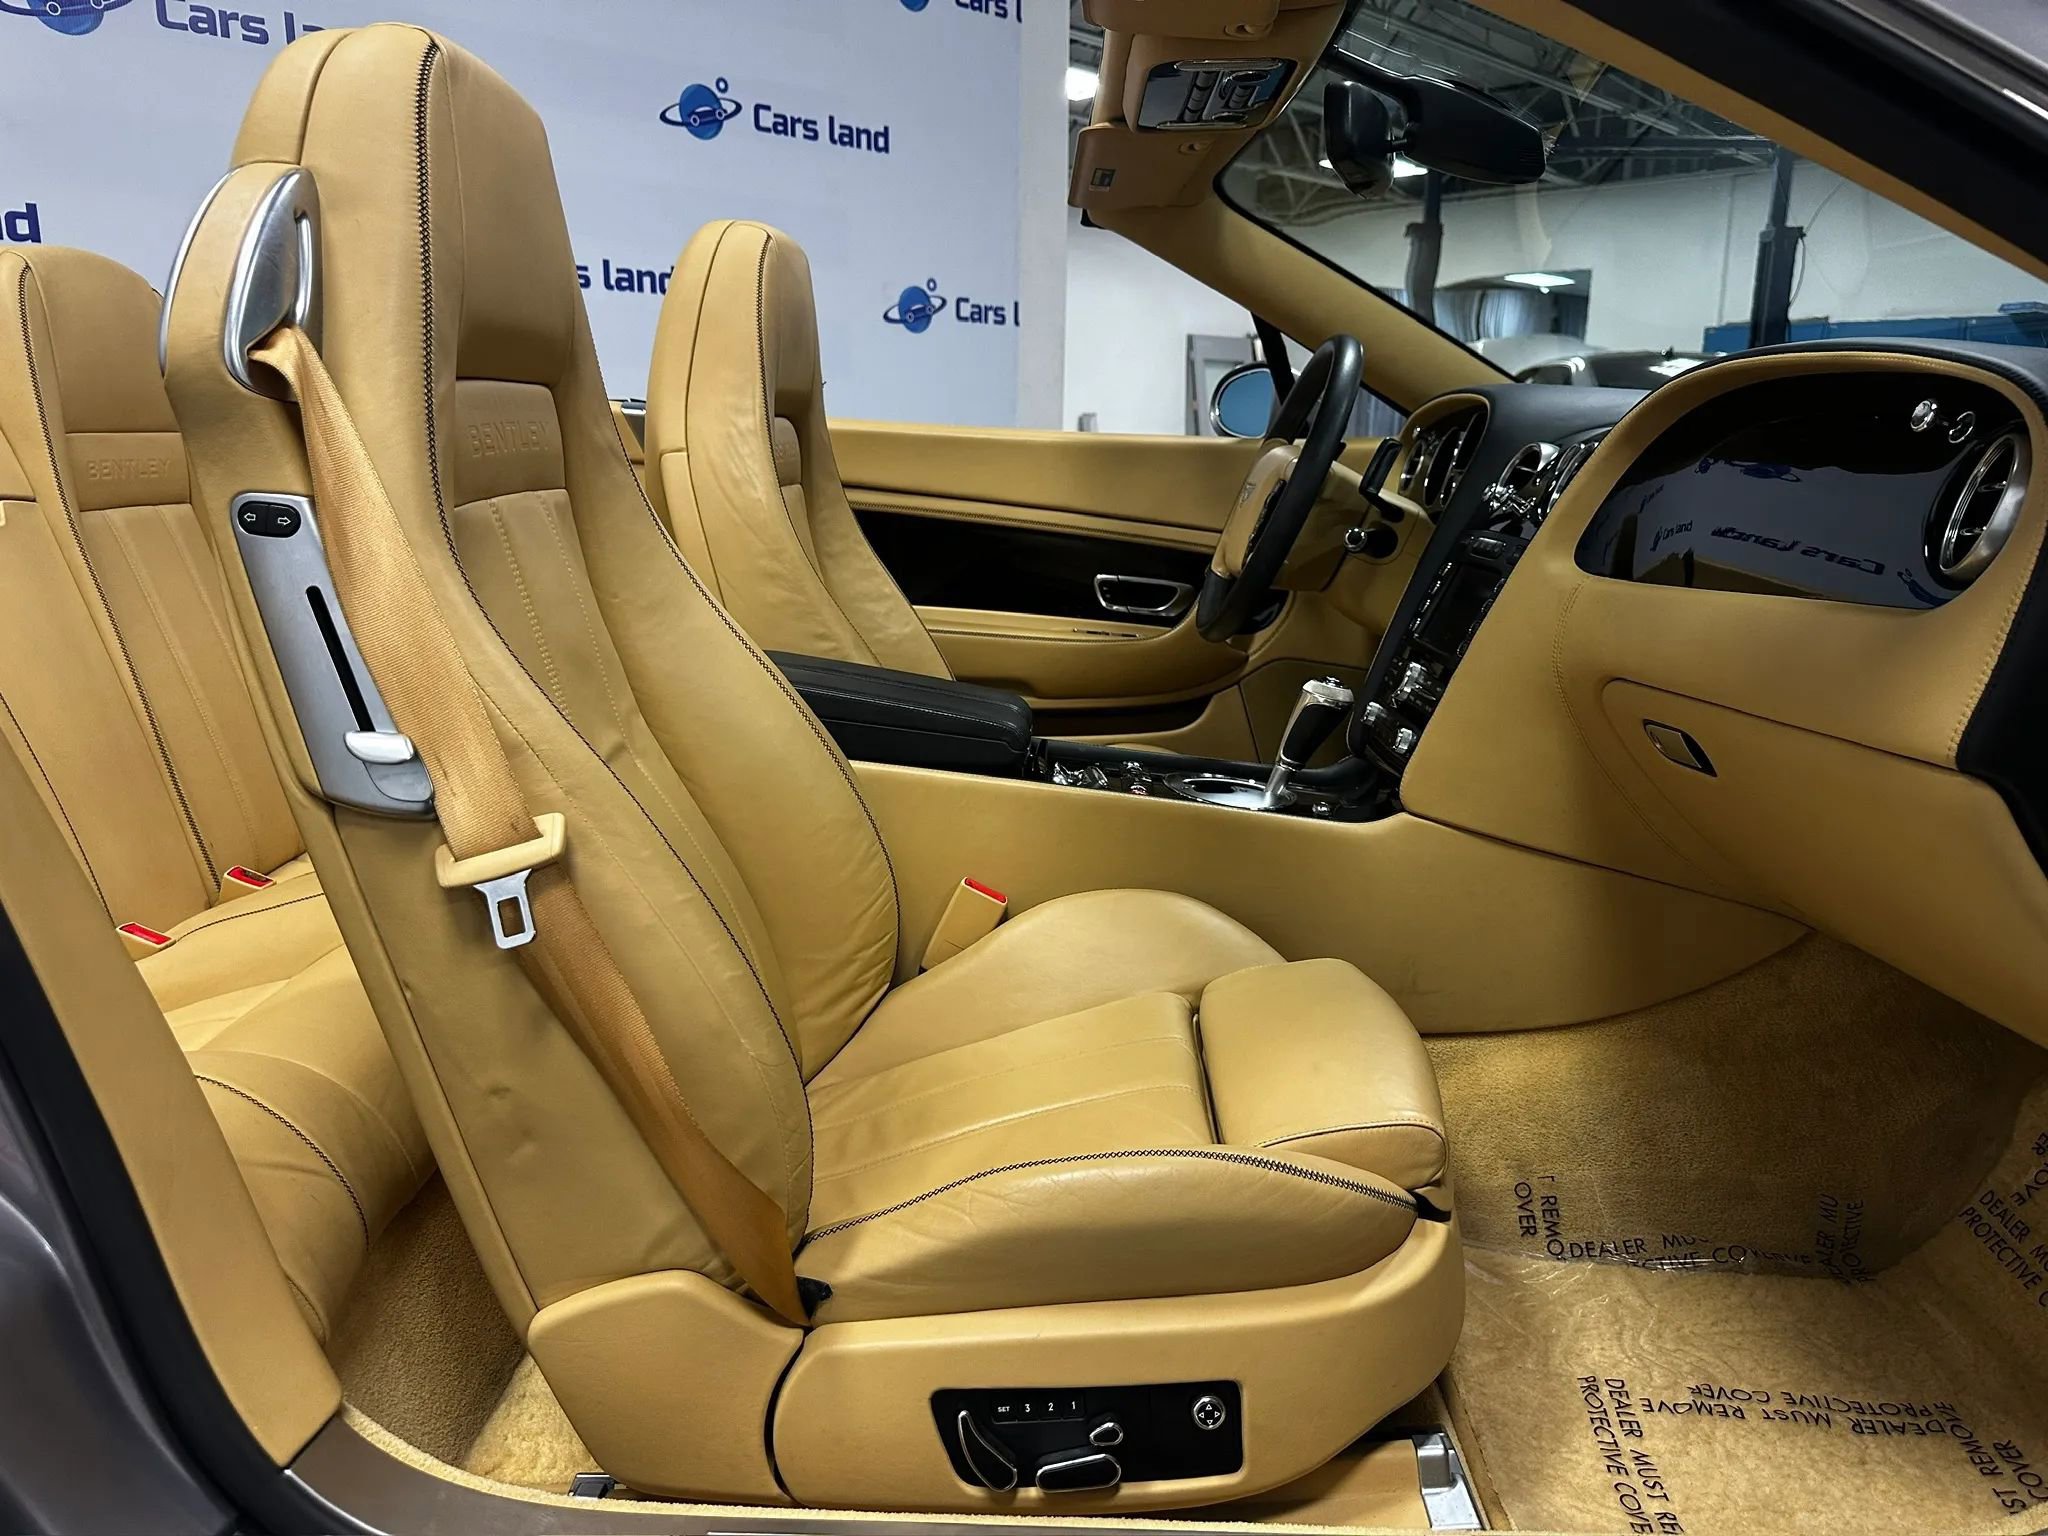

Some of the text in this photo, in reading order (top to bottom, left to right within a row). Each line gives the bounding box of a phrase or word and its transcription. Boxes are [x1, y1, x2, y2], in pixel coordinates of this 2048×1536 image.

[156, 0, 269, 45] Cars
[753, 103, 890, 154] Cars land
[956, 297, 1006, 325] Cars
[466, 420, 550, 458] BENTLEY
[86, 458, 172, 479] BENTLEY
[1979, 1190, 2030, 1243] DEALER
[1569, 1238, 1647, 1258] DEALER
[1959, 1207, 2042, 1290] PROTECTIVE
[1025, 1403, 1031, 1413] 3
[1048, 1402, 1054, 1411] 2
[1071, 1401, 1076, 1410] 1
[1640, 1397, 1946, 1436] DEALER MUST REMOVE
[1687, 1383, 1933, 1417] PROTECTIVE COVER
[1577, 1375, 1629, 1476] PROTECTIVE
[1605, 1379, 1643, 1438] DEALER
[1630, 1449, 1669, 1502] MUST
